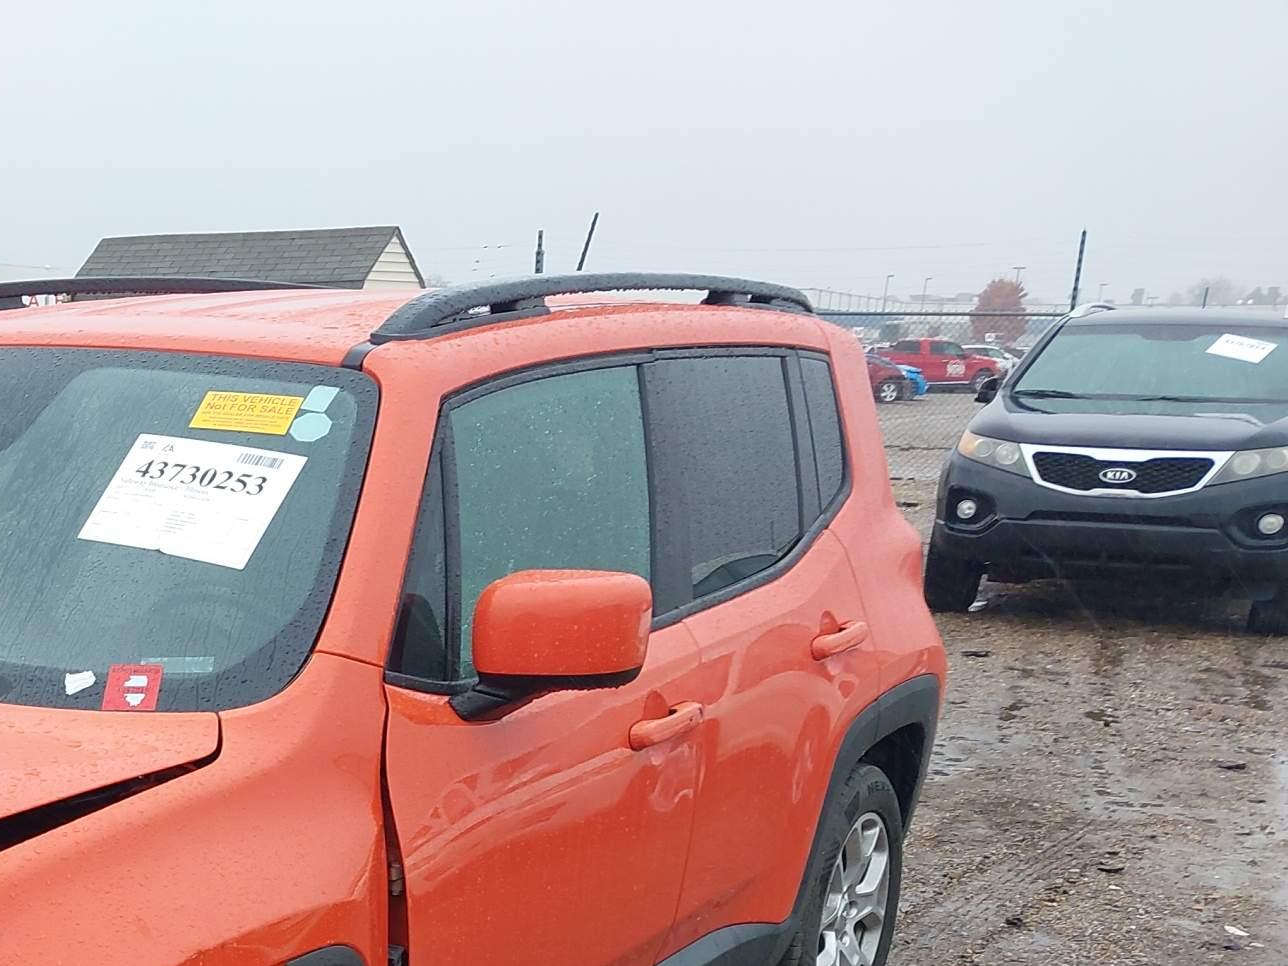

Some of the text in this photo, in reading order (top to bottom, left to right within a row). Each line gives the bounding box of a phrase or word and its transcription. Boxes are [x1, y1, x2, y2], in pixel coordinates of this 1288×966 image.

[211, 393, 300, 407] THIS VEHICLE
[205, 402, 296, 416] Not FOR SALE
[135, 459, 268, 496] 43730253
